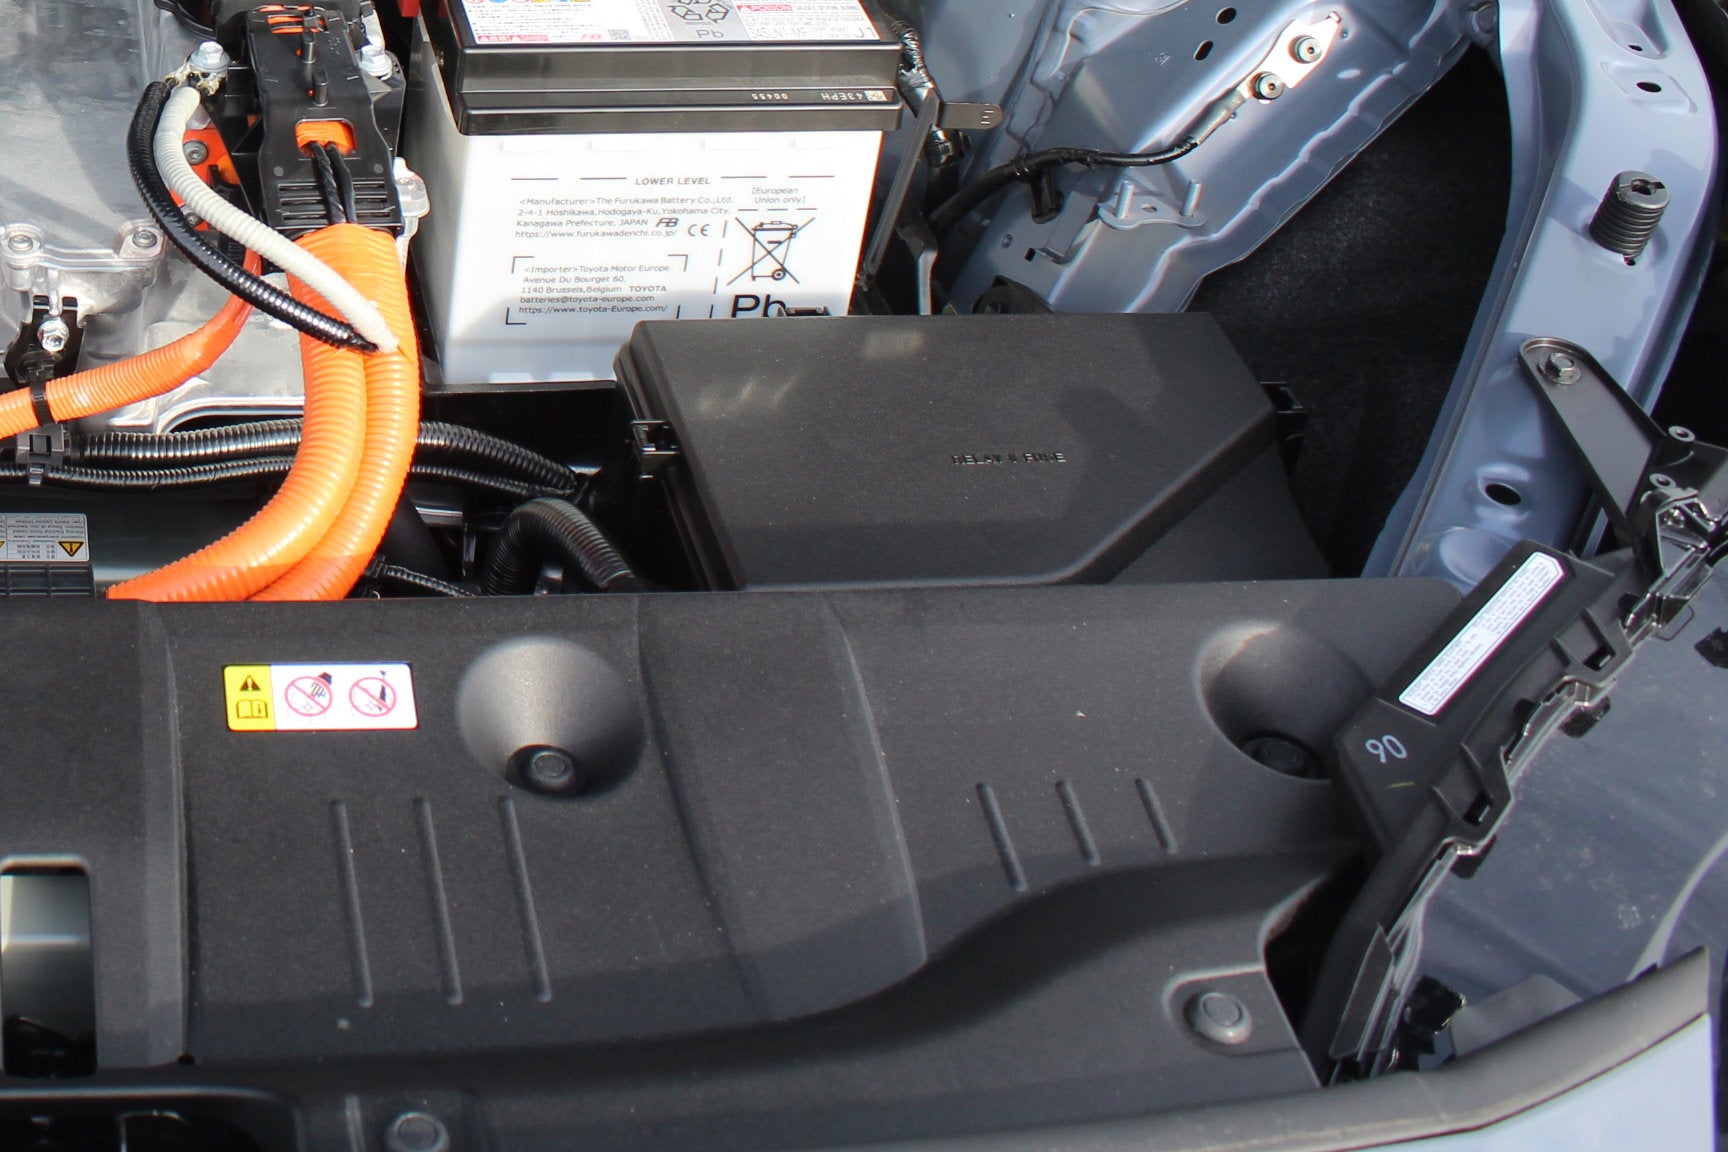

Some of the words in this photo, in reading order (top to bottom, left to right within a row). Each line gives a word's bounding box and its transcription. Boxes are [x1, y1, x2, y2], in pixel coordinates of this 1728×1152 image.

[635, 177, 674, 186] LOWER
[677, 177, 711, 185] LEVEL
[614, 196, 660, 205] Furukawa
[660, 196, 696, 206] Battery
[754, 196, 780, 204] Union
[516, 219, 563, 229] Kanagawa
[619, 218, 649, 226] JAPAN
[611, 264, 637, 272] Motor
[638, 264, 671, 273] Europe
[523, 275, 556, 284] Avenue
[558, 275, 572, 284] Du
[574, 275, 610, 285] Bourget
[521, 286, 544, 294] 1140
[628, 284, 668, 293] TOYOTA
[519, 295, 655, 305] batteries@toyota-europe.com
[1023, 451, 1067, 464] FUSE
[1364, 734, 1408, 763] 90
